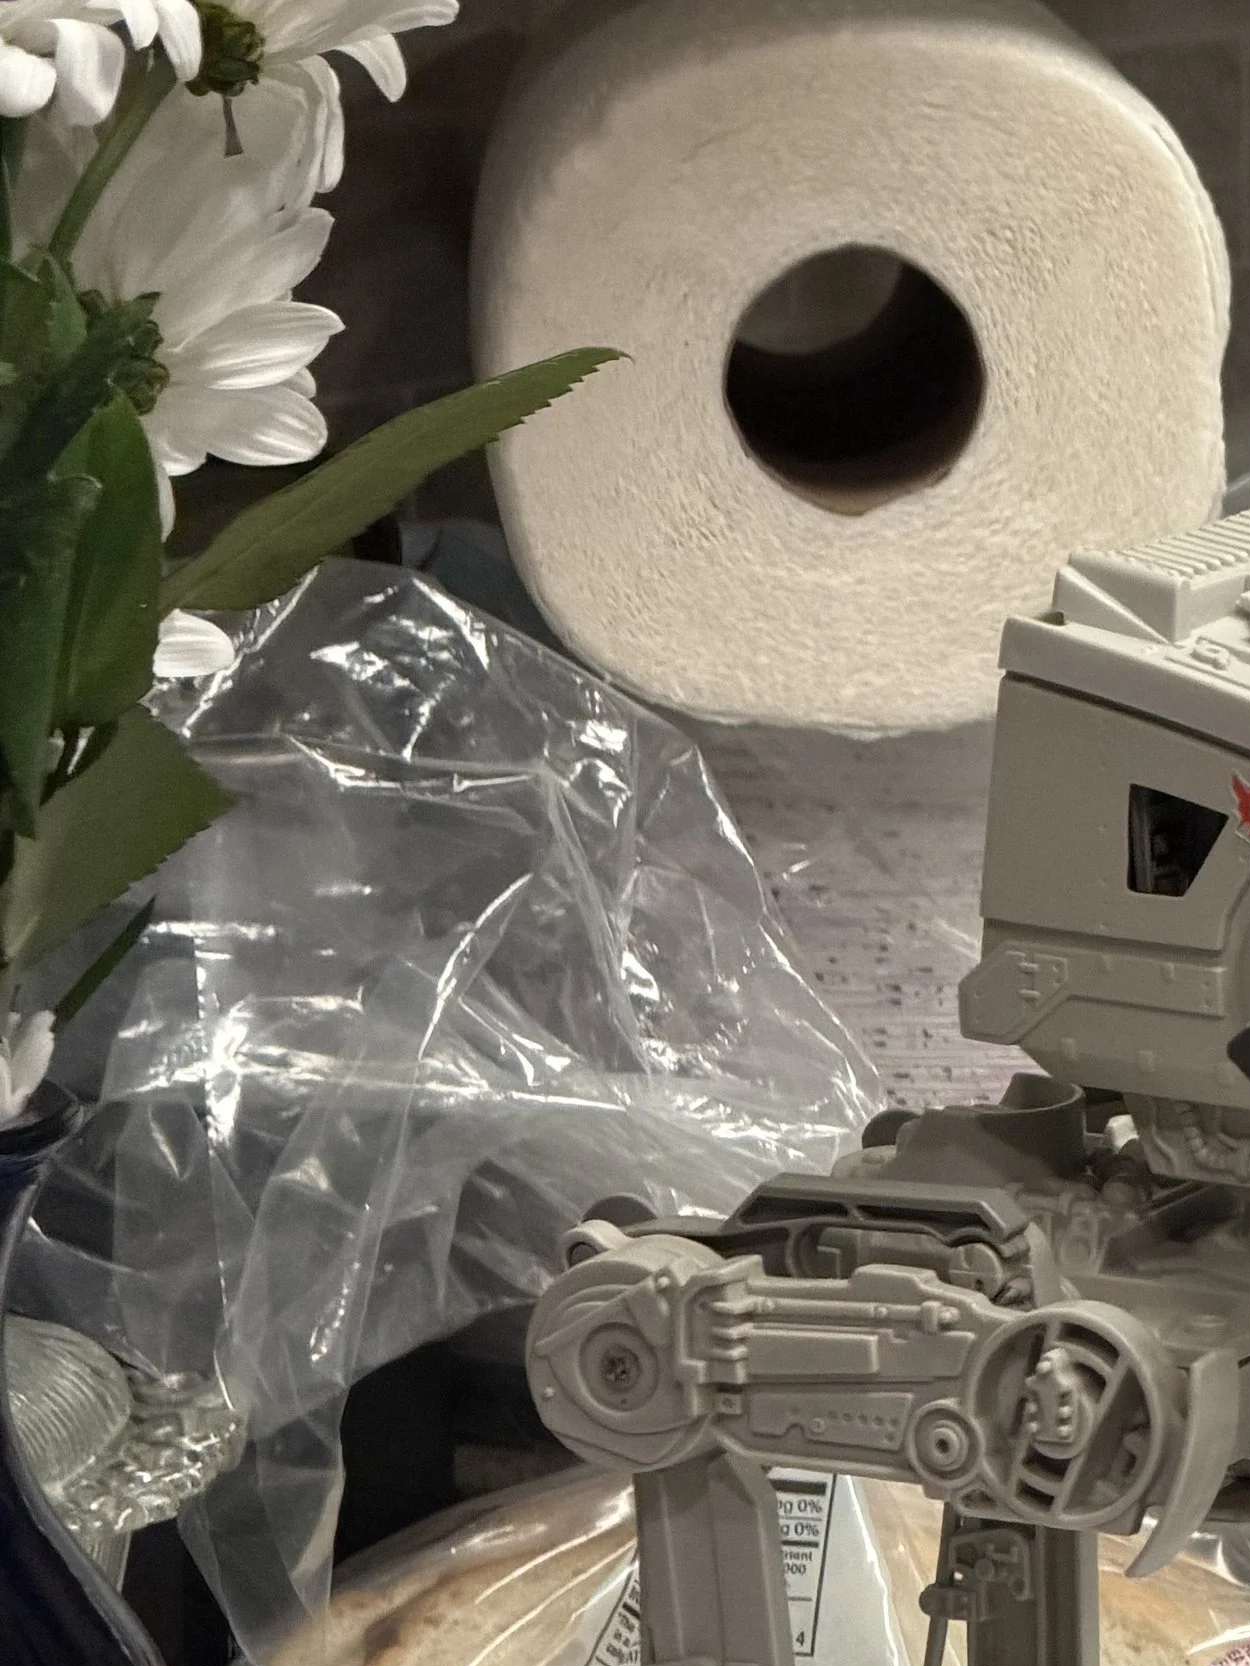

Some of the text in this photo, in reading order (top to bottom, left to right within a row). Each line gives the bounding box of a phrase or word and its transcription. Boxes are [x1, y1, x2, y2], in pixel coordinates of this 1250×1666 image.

[798, 1500, 822, 1513] 0%
[795, 1523, 819, 1536] 0%
[795, 1631, 805, 1646] 4
